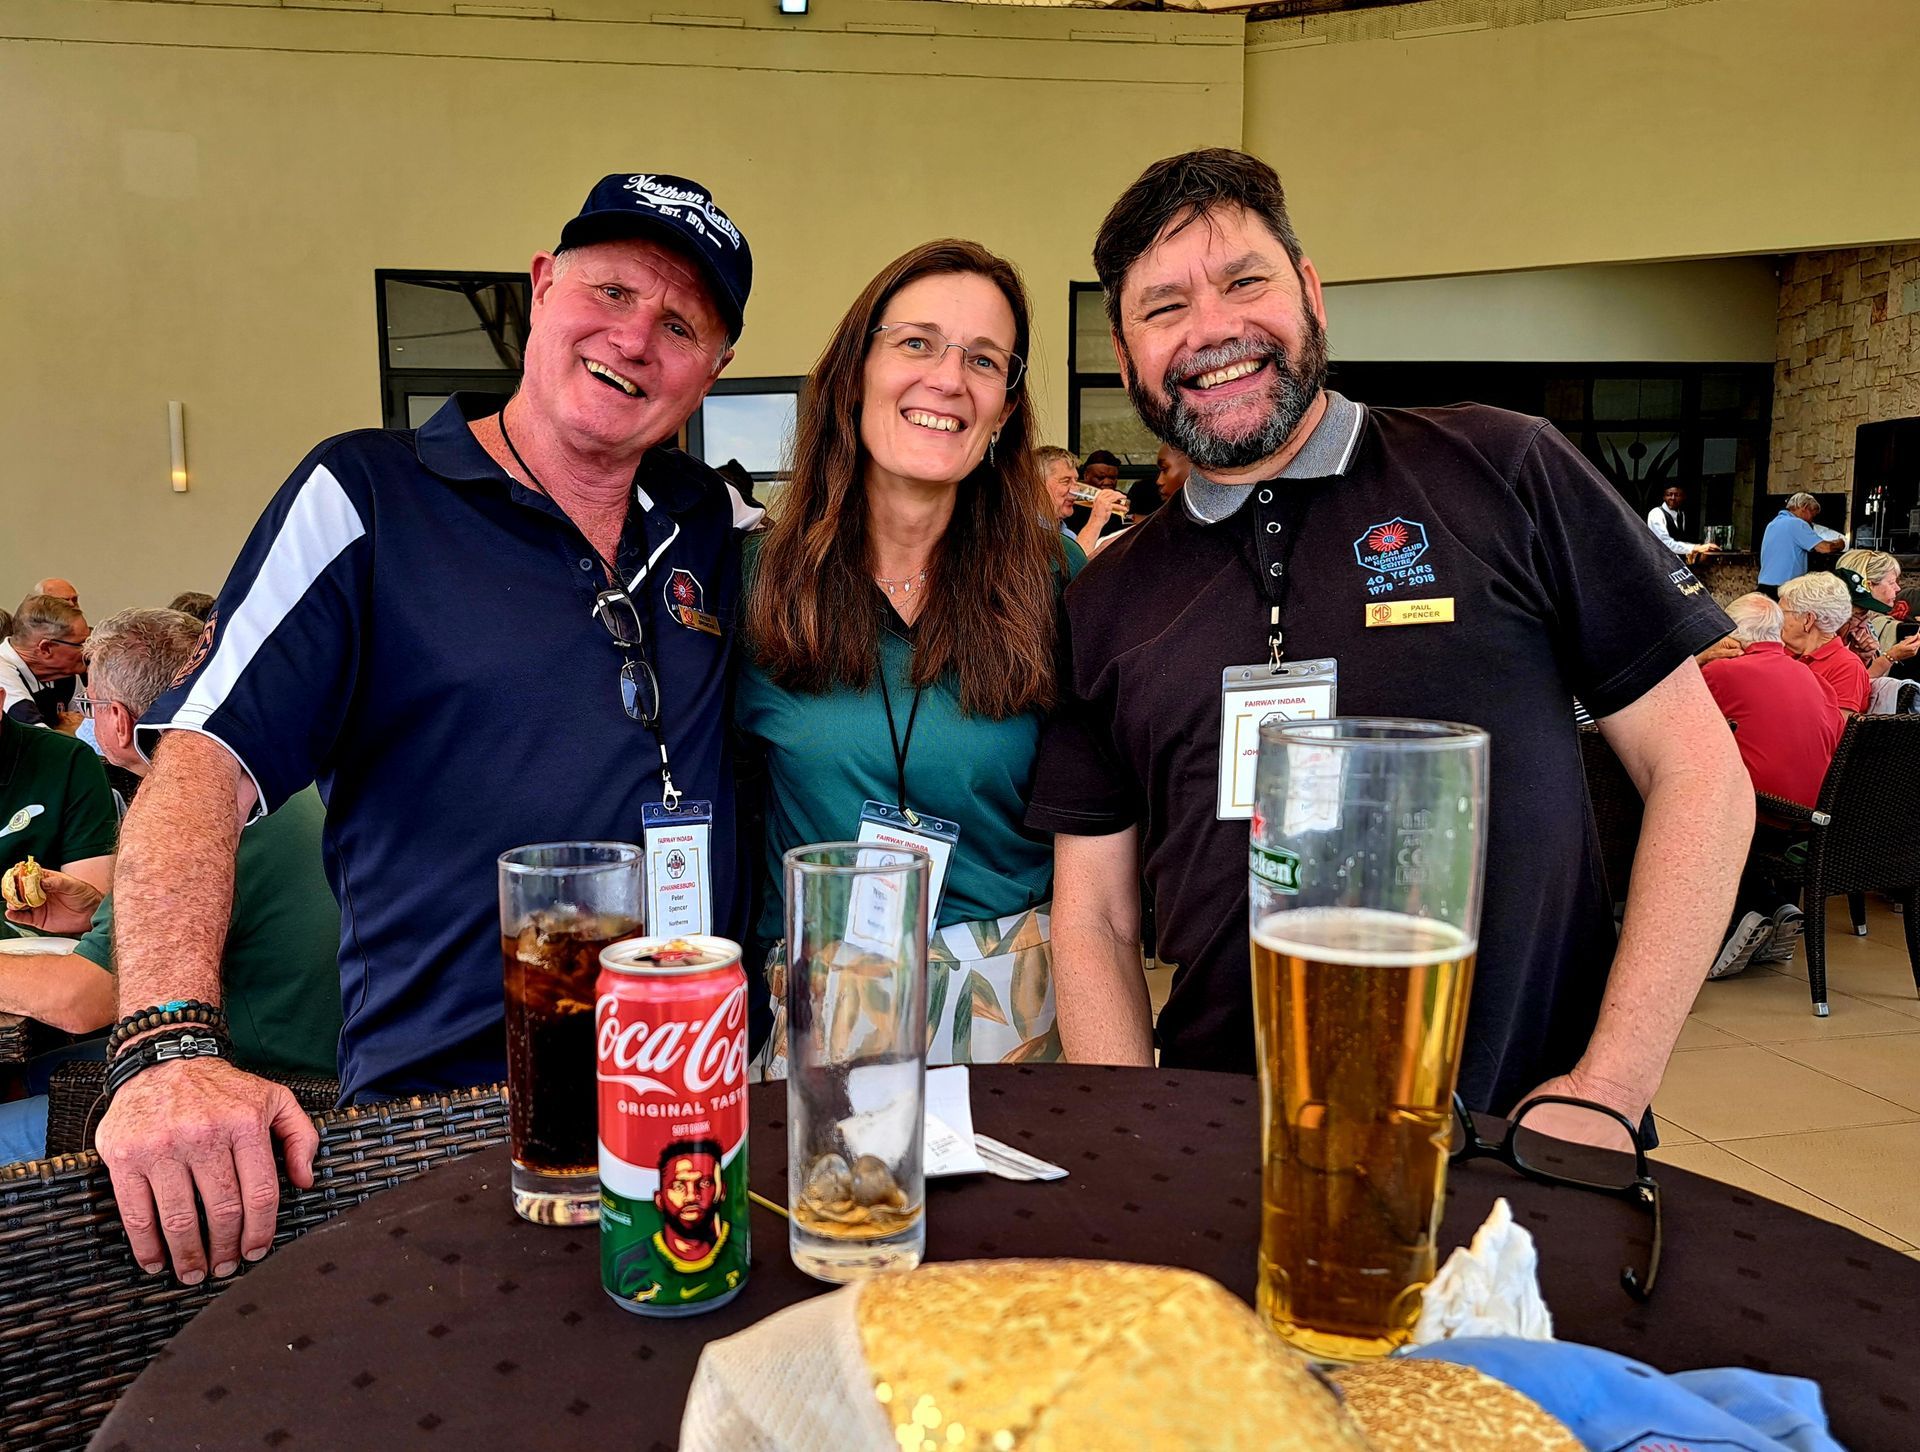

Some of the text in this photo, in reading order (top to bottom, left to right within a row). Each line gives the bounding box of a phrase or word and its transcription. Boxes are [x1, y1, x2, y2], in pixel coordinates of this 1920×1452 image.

[623, 174, 741, 246] Northern Centre
[658, 204, 706, 235] EST. 1978
[1364, 543, 1423, 564] MG CAR CLUB
[1373, 552, 1416, 567] NORTHERN
[1380, 558, 1411, 570] CENTRE
[1366, 564, 1433, 587] 40 YEARS
[1368, 582, 1394, 596] 1978
[1408, 573, 1436, 586] 2018
[1402, 611, 1440, 619] SPENCER
[1244, 697, 1306, 708] FAIRWAY INDABA
[876, 833, 905, 847] FAIRWAY
[671, 894, 685, 902] Peter
[668, 904, 688, 913] Spencer
[617, 1098, 705, 1118] ORIGINAL
